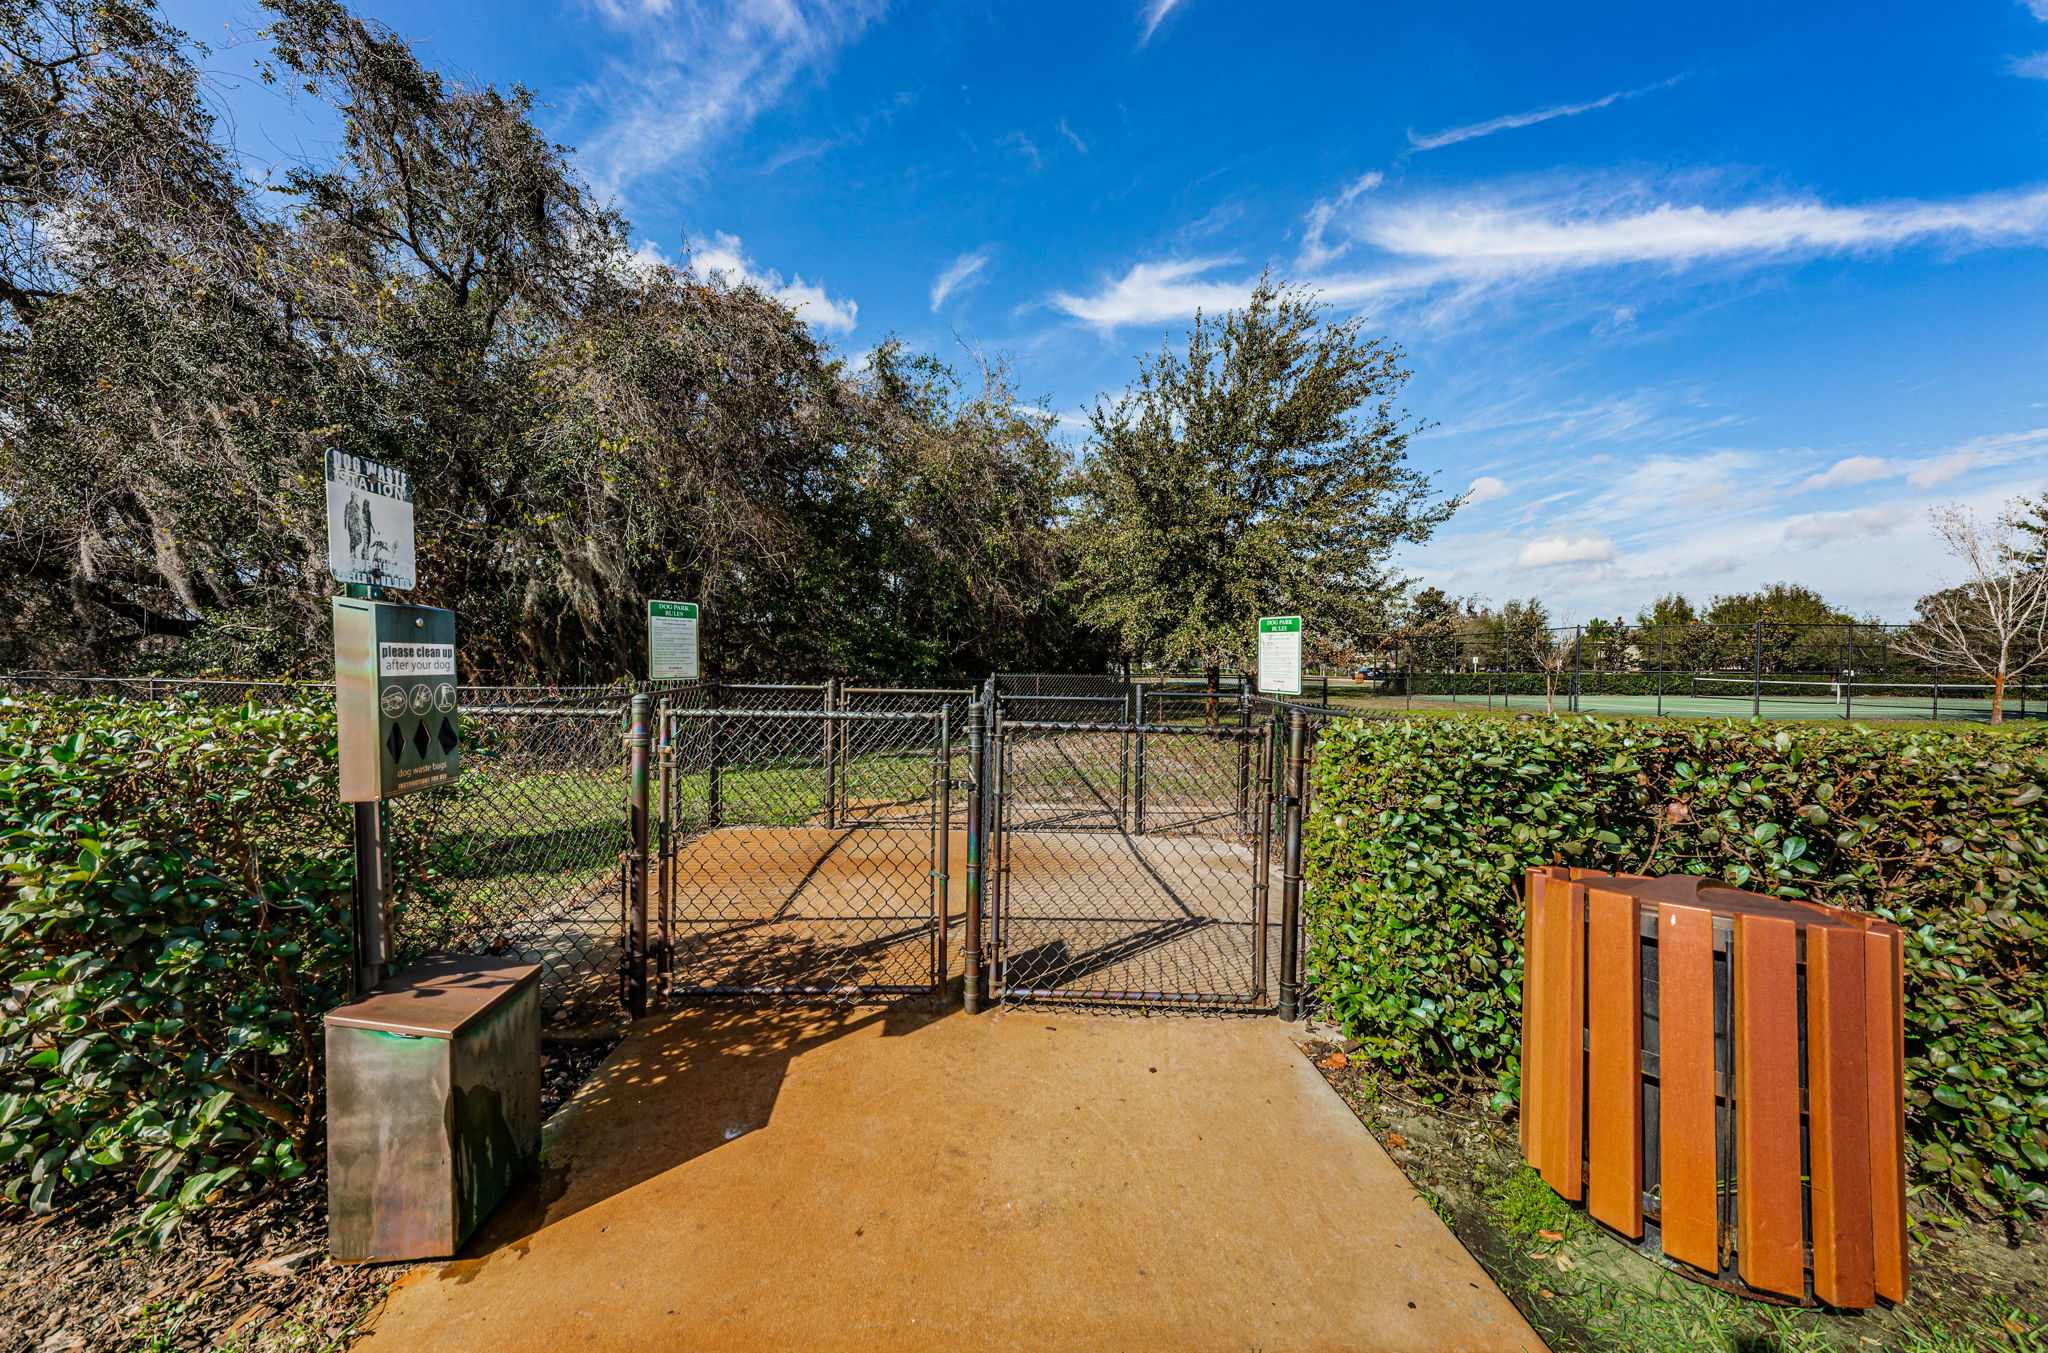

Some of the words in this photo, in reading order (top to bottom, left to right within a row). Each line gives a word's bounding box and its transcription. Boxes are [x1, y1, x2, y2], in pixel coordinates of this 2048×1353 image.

[333, 450, 361, 473] DOG
[365, 461, 407, 486] WASTE
[336, 469, 404, 501] STATION
[382, 646, 414, 658] please
[416, 646, 441, 657] clean
[442, 648, 453, 658] up
[386, 659, 409, 670] after
[410, 661, 432, 672] your
[433, 659, 451, 671] dog
[398, 768, 412, 777] dog
[412, 764, 432, 774] waste
[432, 761, 448, 771] bags
